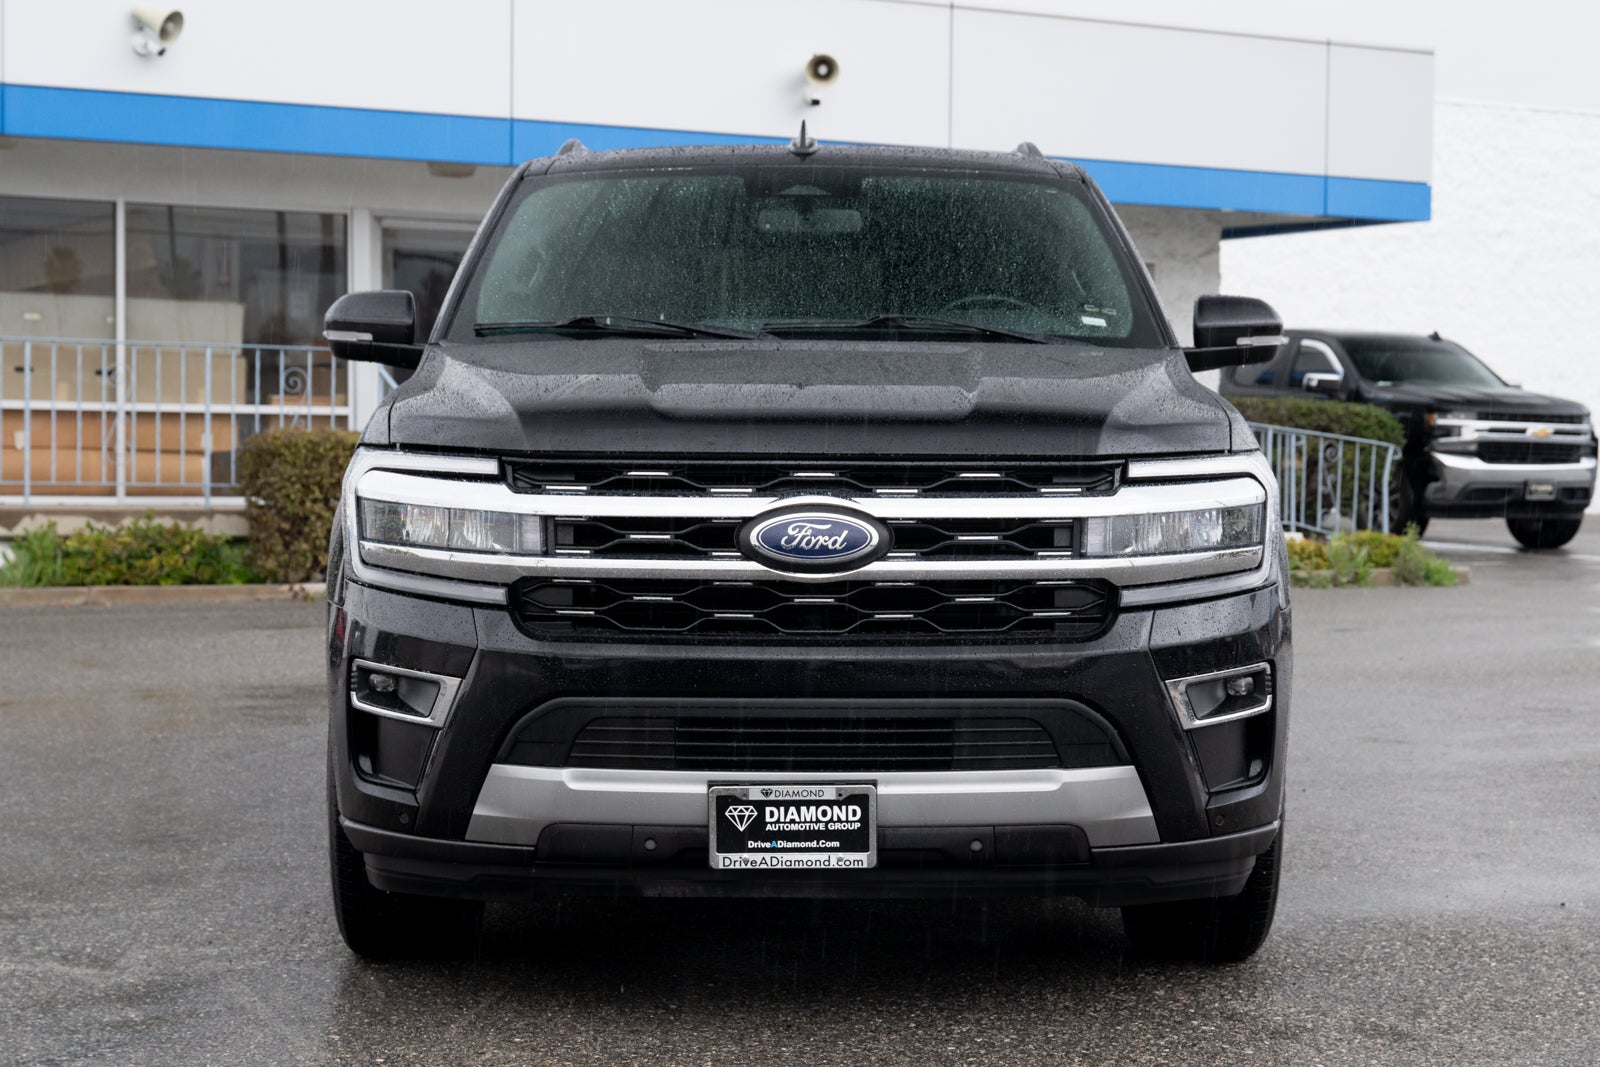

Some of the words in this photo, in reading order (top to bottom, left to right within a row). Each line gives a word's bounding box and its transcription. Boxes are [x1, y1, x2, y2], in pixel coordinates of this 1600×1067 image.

[781, 522, 848, 550] Ford
[774, 789, 825, 798] DIAMOND
[765, 805, 862, 822] DIAMOND
[765, 822, 826, 831] AUTOMOTIVE
[828, 822, 861, 830] GROUP
[748, 840, 840, 848] DriveADiamond.Com
[722, 855, 864, 867] DriveADiamond.com
